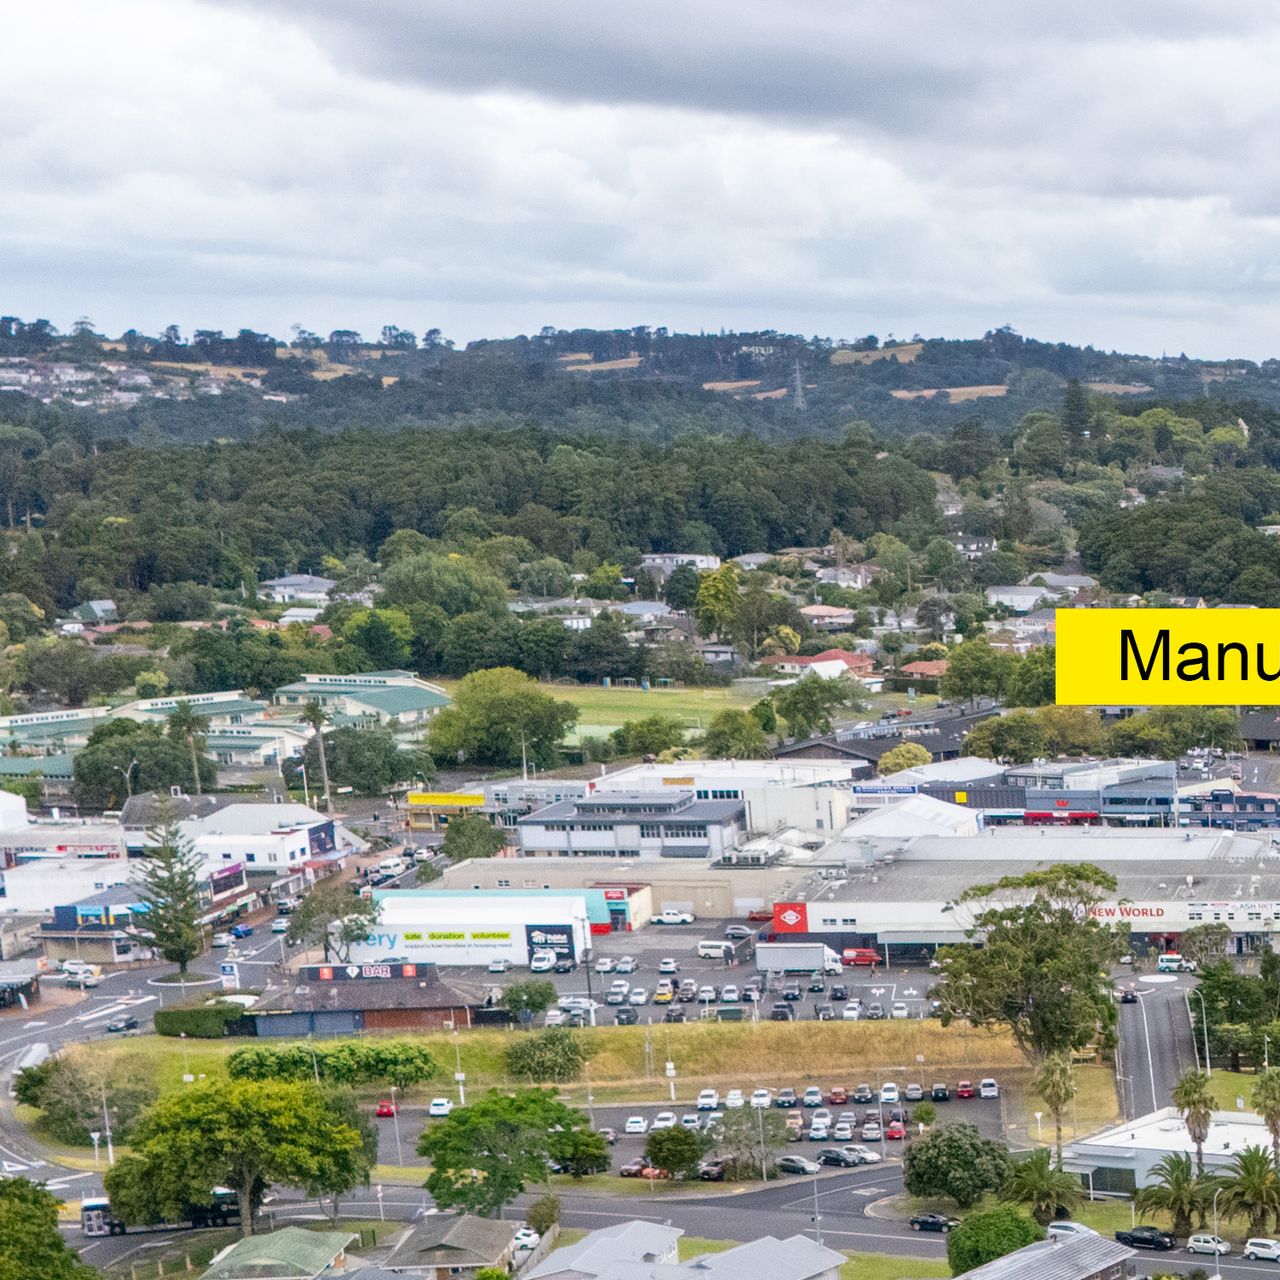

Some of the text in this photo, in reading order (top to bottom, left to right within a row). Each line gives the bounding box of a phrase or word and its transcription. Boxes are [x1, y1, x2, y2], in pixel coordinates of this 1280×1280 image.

[1089, 906, 1164, 917] NEW WORLD
[428, 932, 465, 940] donation
[471, 932, 510, 940] volunteer
[362, 965, 391, 978] BAR
